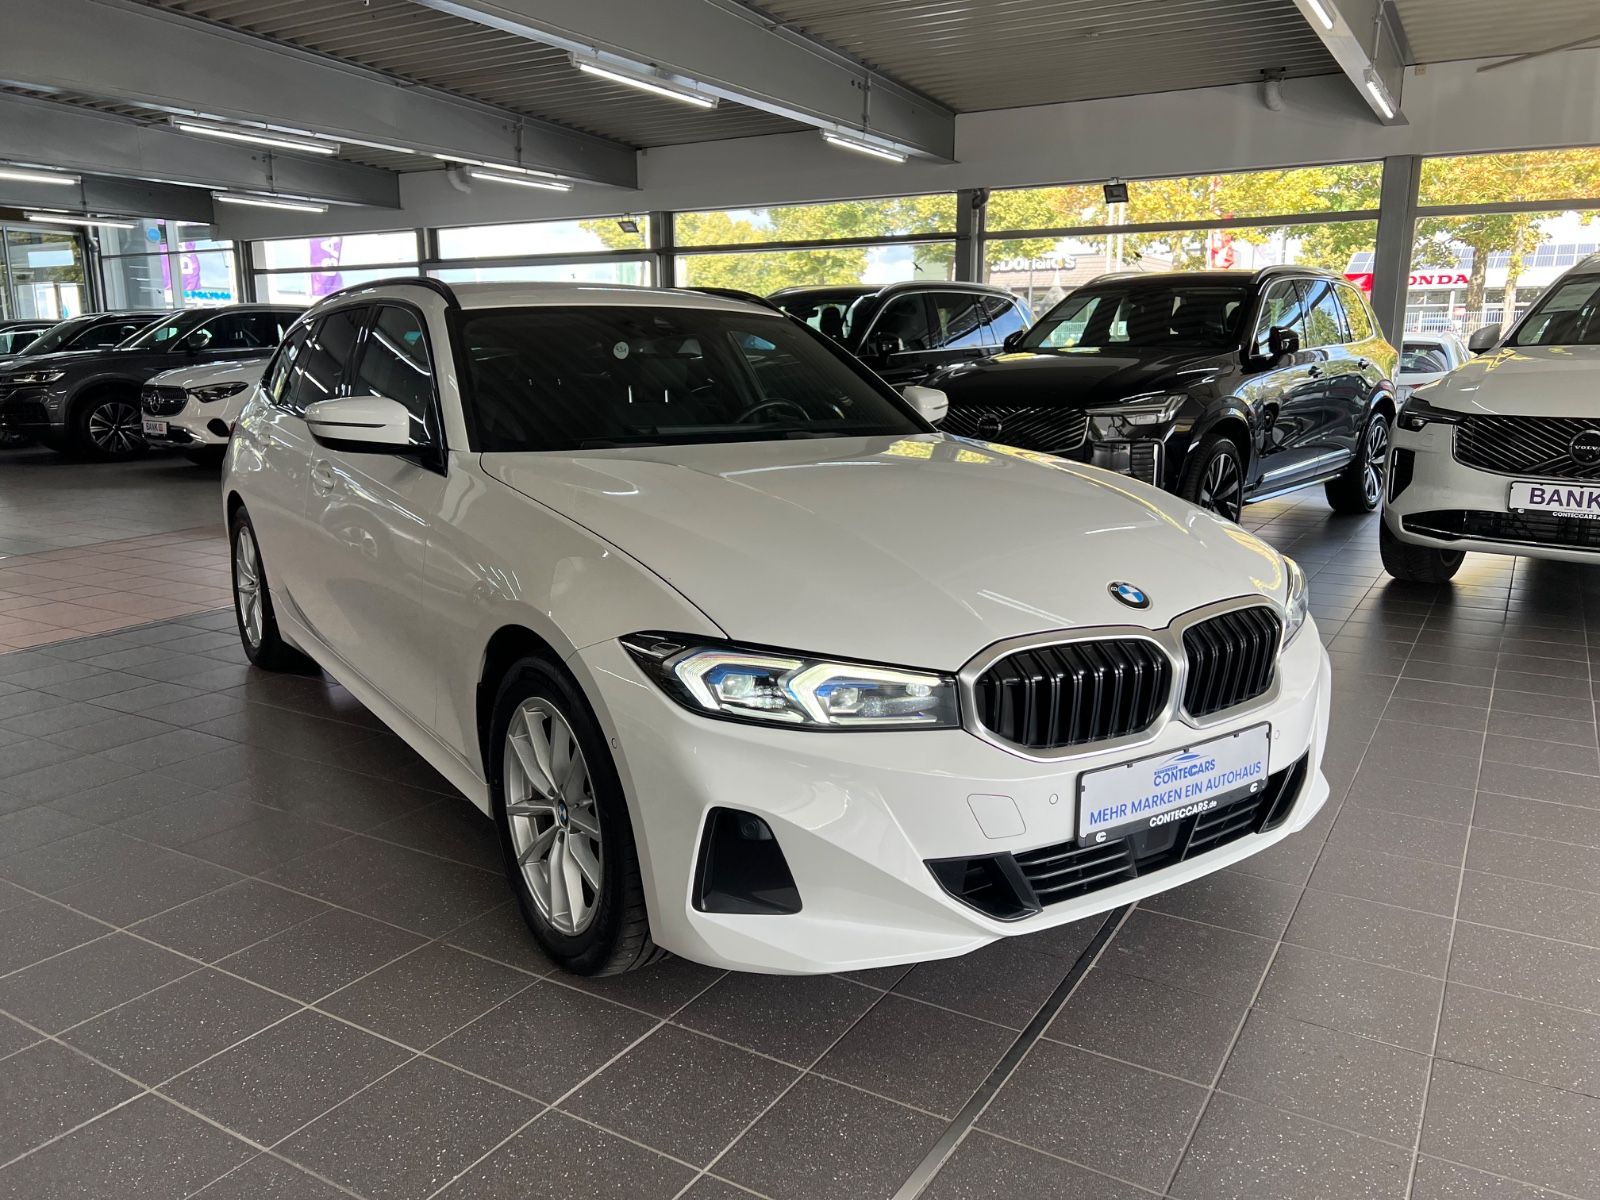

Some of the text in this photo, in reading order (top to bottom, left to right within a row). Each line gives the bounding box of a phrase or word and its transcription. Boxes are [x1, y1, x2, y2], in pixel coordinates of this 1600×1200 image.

[1409, 274, 1468, 285] ONDA
[1529, 487, 1600, 510] BANK
[1090, 803, 1127, 825] MEHR
[1131, 787, 1182, 814] MARKEN
[1185, 782, 1203, 798] EIN
[1206, 761, 1261, 791] AUTOHAUS
[1149, 800, 1217, 827] CONTECCARS.de
